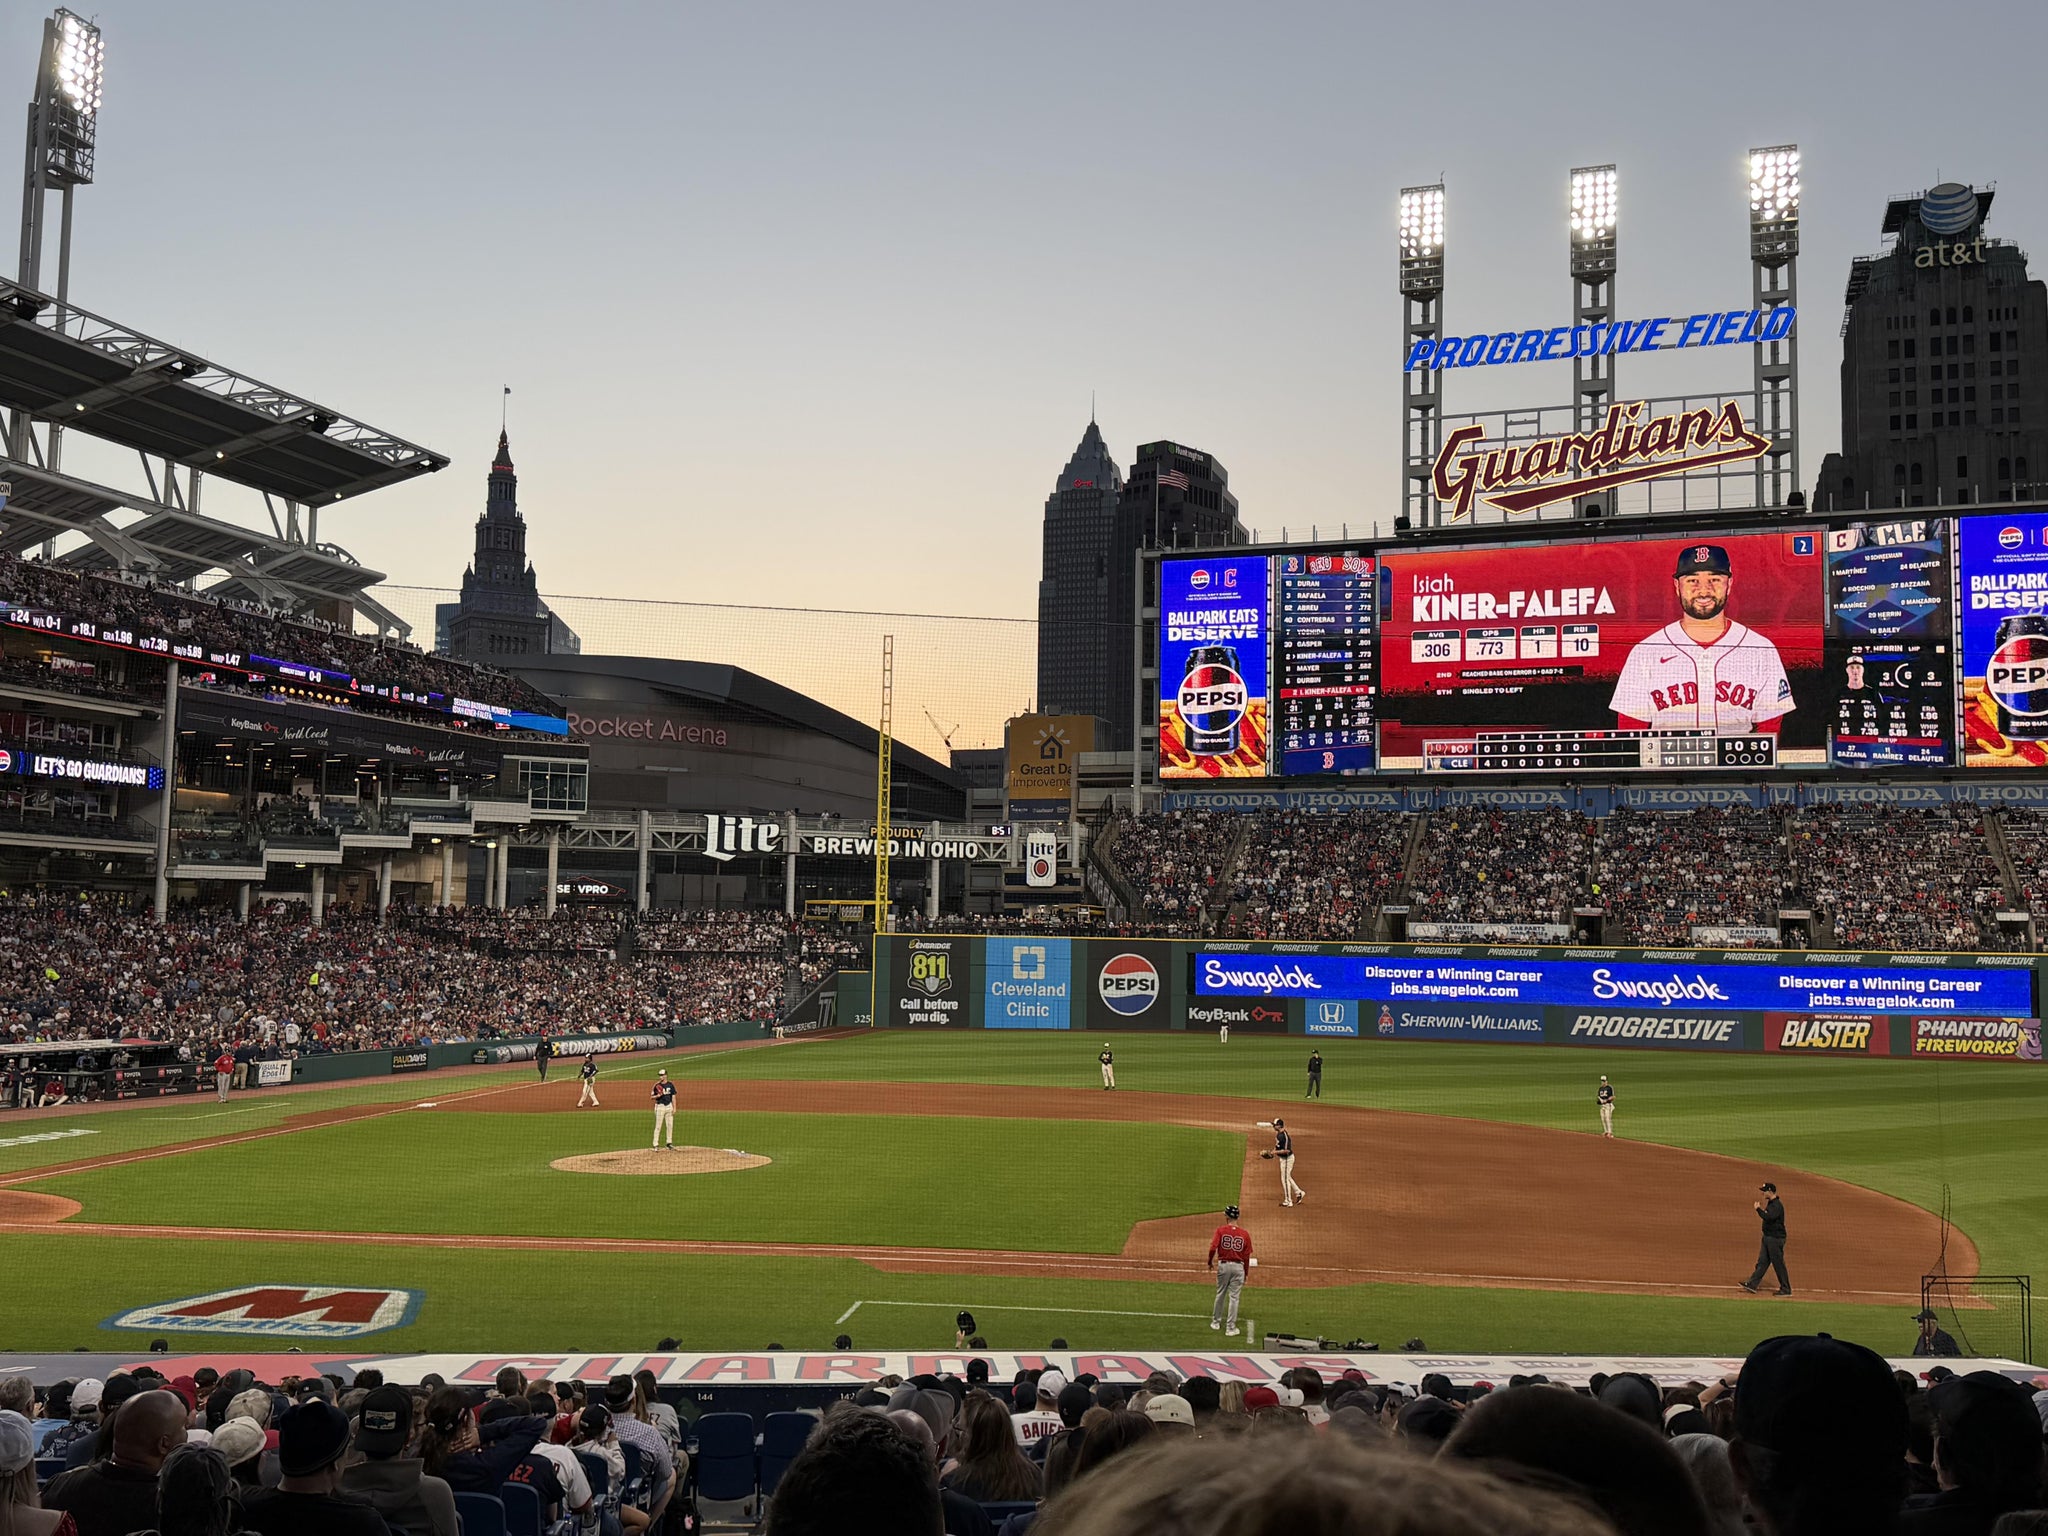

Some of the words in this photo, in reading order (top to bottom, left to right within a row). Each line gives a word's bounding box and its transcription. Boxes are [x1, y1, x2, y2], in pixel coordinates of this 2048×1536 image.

[1914, 236, 1987, 269] at&t
[1403, 317, 1672, 373] PROGRESSIVE
[1676, 307, 1798, 349] FIELD
[1431, 400, 1773, 522] Guardians
[1877, 521, 1926, 545] CLE
[1800, 539, 1808, 553] 2
[1310, 556, 1332, 573] RED
[1342, 557, 1369, 573] SOX
[1909, 561, 1940, 569] DELAUTER
[1413, 573, 1454, 593] Isiah
[1971, 573, 2048, 591] BALLPARK
[1413, 586, 1616, 622] KINER-FALEFA
[1168, 611, 1228, 626] BALLPARK
[1229, 609, 1259, 624] EATS
[17, 610, 30, 624] 24
[46, 615, 60, 630] 0-1
[79, 623, 95, 637] 18.1
[114, 630, 133, 645] 1.96
[150, 637, 168, 652] 7.36
[187, 644, 202, 658] 5.89
[225, 652, 240, 667] 1.47
[1168, 624, 1259, 642] DESERVE
[1421, 644, 1451, 657] .306
[1476, 641, 1504, 656] .773
[1574, 638, 1589, 652] 10
[1883, 672, 1889, 681] 3
[1927, 672, 1935, 680] 3
[1182, 691, 1243, 706] PEPSI
[1305, 687, 1352, 695] KINER-FALEFA
[1651, 682, 1698, 711] RED
[1715, 681, 1758, 711] SOX
[231, 718, 262, 731] KeyBank
[567, 713, 653, 739] Rocket
[659, 719, 727, 746] Arena
[386, 744, 411, 754] KeyBank
[1451, 745, 1468, 753] BOS
[1735, 741, 1743, 750] 0
[1751, 742, 1758, 750] S
[1760, 741, 1769, 750] 0
[34, 756, 65, 775] LET'S
[67, 760, 82, 776] GO
[83, 761, 146, 785] GUARDIANS!
[1020, 763, 1055, 775] Great
[1451, 759, 1468, 768] CLE
[1193, 794, 1280, 806] HONDA
[1307, 793, 1398, 806] HONDA
[1469, 791, 1568, 805] HONDA
[1647, 789, 1752, 803] HONDA
[1835, 787, 1944, 801] HONDA
[702, 813, 780, 862] Lite
[871, 827, 923, 838] PROUDLY
[814, 837, 899, 856] BREWED
[905, 841, 925, 857] IN
[931, 842, 978, 858] OHIO
[1029, 842, 1054, 858] Lite
[1204, 943, 1250, 951] PROGRESSIVE
[1272, 944, 1319, 953] PROGRESSIVE
[1342, 945, 1391, 954] PROGRESSIVE
[1413, 946, 1464, 955] PROGRESSIVE
[1488, 948, 1539, 957] PROGRESSIVE
[1564, 949, 1617, 958] PROGRESSIVE
[1642, 951, 1696, 960] PROGRESSIVE
[1723, 952, 1780, 961] PROGRESSIVE
[1805, 954, 1862, 963] PROGRESSIVE
[1889, 955, 1948, 965] PROGRESSIVE
[1976, 956, 2036, 966] PROGRESSIVE
[912, 954, 946, 980] 811
[1365, 966, 1424, 980] Discover
[1426, 969, 1435, 980] a
[1437, 968, 1493, 983] Winning
[1495, 969, 1543, 983] Career
[1103, 978, 1155, 991] PEPSI
[1205, 960, 1322, 994] Swagelok
[1779, 975, 1846, 989] Discover
[1849, 978, 1859, 989] a
[1861, 977, 1925, 992] Winning
[1929, 978, 1982, 992] Career
[991, 982, 1066, 997] Cleveland
[1390, 982, 1519, 998] jobs.swagelok.com
[1592, 969, 1729, 1006] Swagelok
[900, 998, 921, 1010] Call
[924, 998, 959, 1010] before
[1808, 992, 1955, 1009] jobs.swagelok.com
[1006, 1001, 1050, 1017] Clinic
[1188, 1007, 1249, 1022] KeyBank
[854, 1014, 871, 1023] 325
[909, 1013, 929, 1024] you
[929, 1011, 950, 1025] dig.
[1309, 1024, 1354, 1033] HONDA
[1570, 1015, 1736, 1041] PROGRESSIVE
[1781, 1020, 1870, 1048] BLASTER
[1917, 1020, 2019, 1038] PHANTOM
[560, 1038, 618, 1056] CONRAD'S
[1916, 1040, 2017, 1055] FIREWORKS
[260, 1063, 279, 1071] VISUAL
[262, 1070, 278, 1078] EDGE
[1221, 1234, 1244, 1252] 83
[133, 1316, 362, 1333] Marathon
[455, 1355, 1379, 1384] GUARDIANS
[696, 1392, 713, 1401] 144
